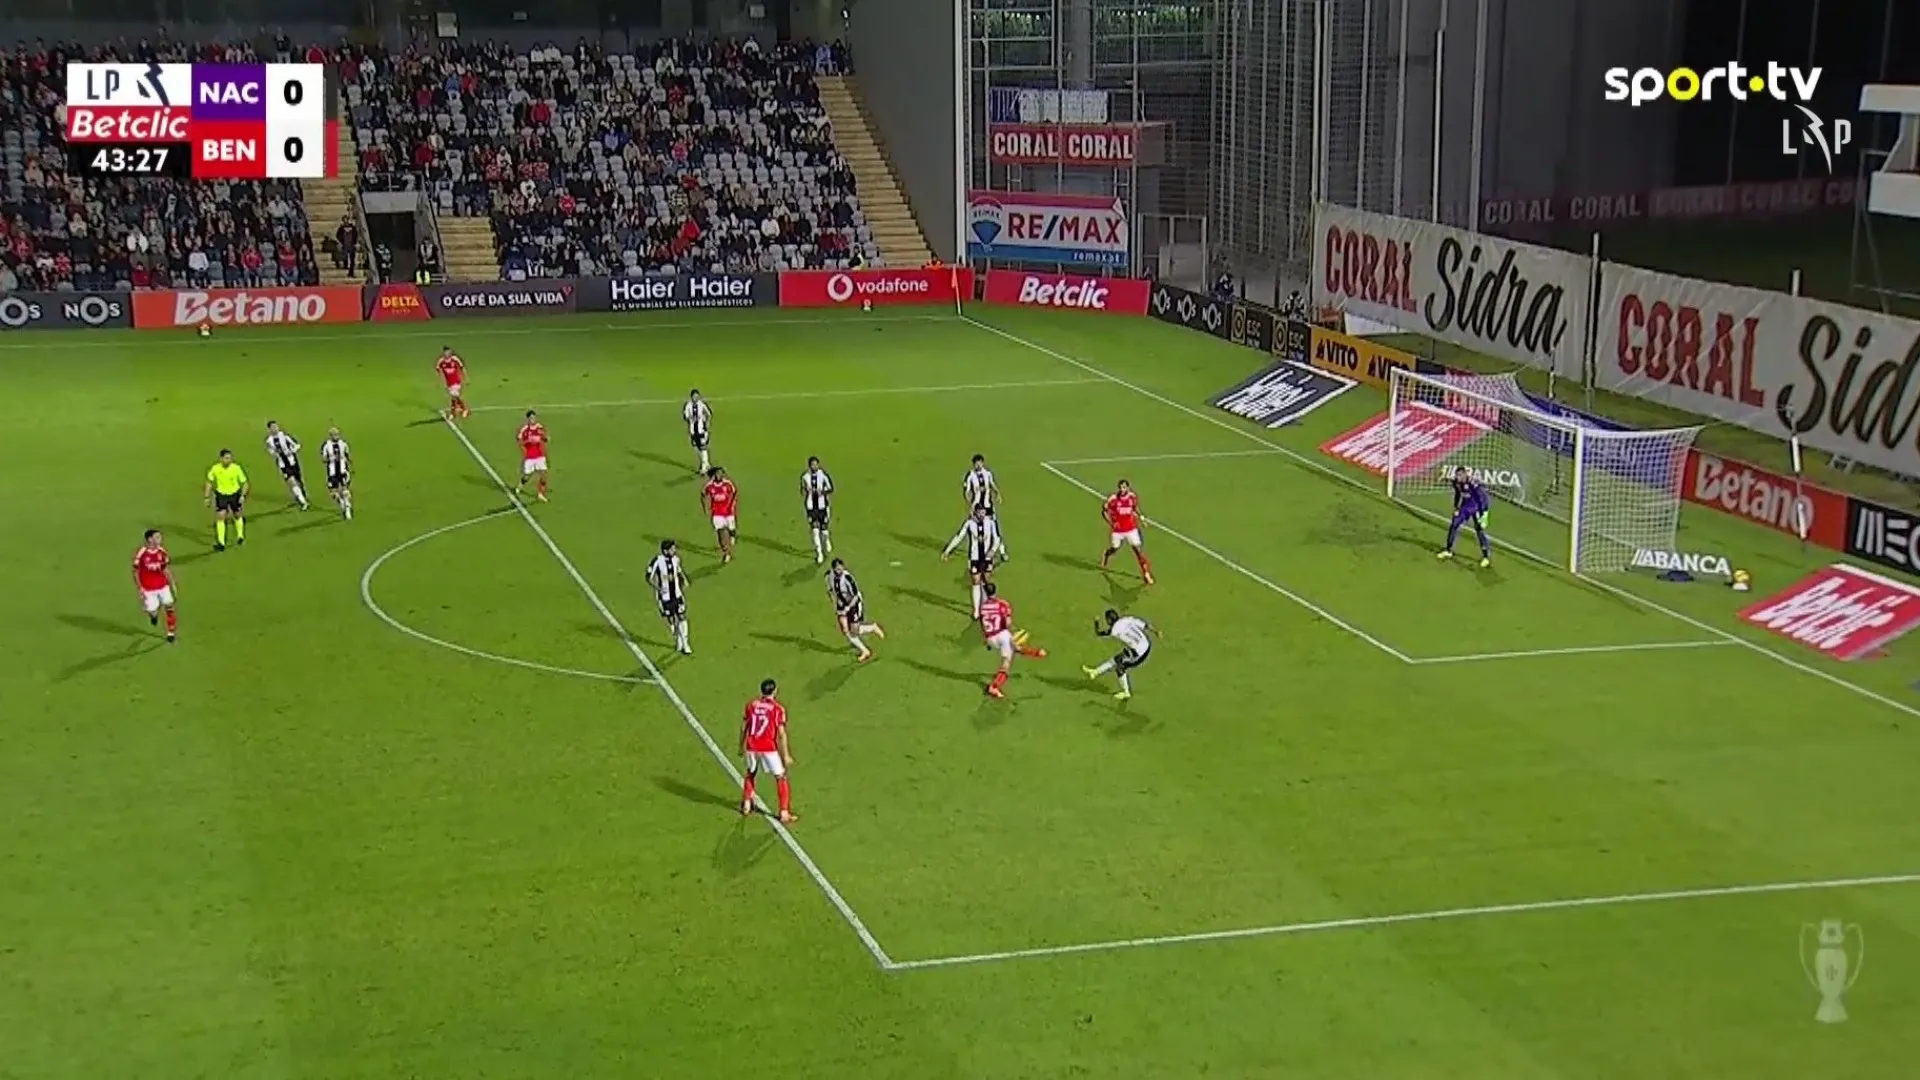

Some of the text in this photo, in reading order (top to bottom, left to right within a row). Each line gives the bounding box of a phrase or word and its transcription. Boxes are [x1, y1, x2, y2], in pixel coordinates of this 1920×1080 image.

[993, 131, 1134, 160] CORAL CORAL
[1484, 199, 1556, 224] CORAL
[1569, 196, 1643, 221] CORAL
[1008, 212, 1122, 244] RE/MAX
[382, 295, 420, 308] DELTA
[443, 291, 565, 307] O CAFÉ DA SUA VIDA
[611, 275, 752, 300] Haier Haier
[857, 277, 929, 295] vodafone
[1019, 276, 1110, 310] Betclic
[1325, 223, 1568, 357] CORAL Sidra
[0, 296, 121, 327] OS NOS
[174, 291, 326, 326] Betano
[1152, 287, 1222, 331] NOS NOS NOS
[1326, 338, 1359, 372] VITO
[1617, 293, 1920, 451] CORAL Sid
[1695, 454, 1815, 535] Betano
[1748, 575, 1912, 650] Betclic
[750, 714, 769, 738] 17
